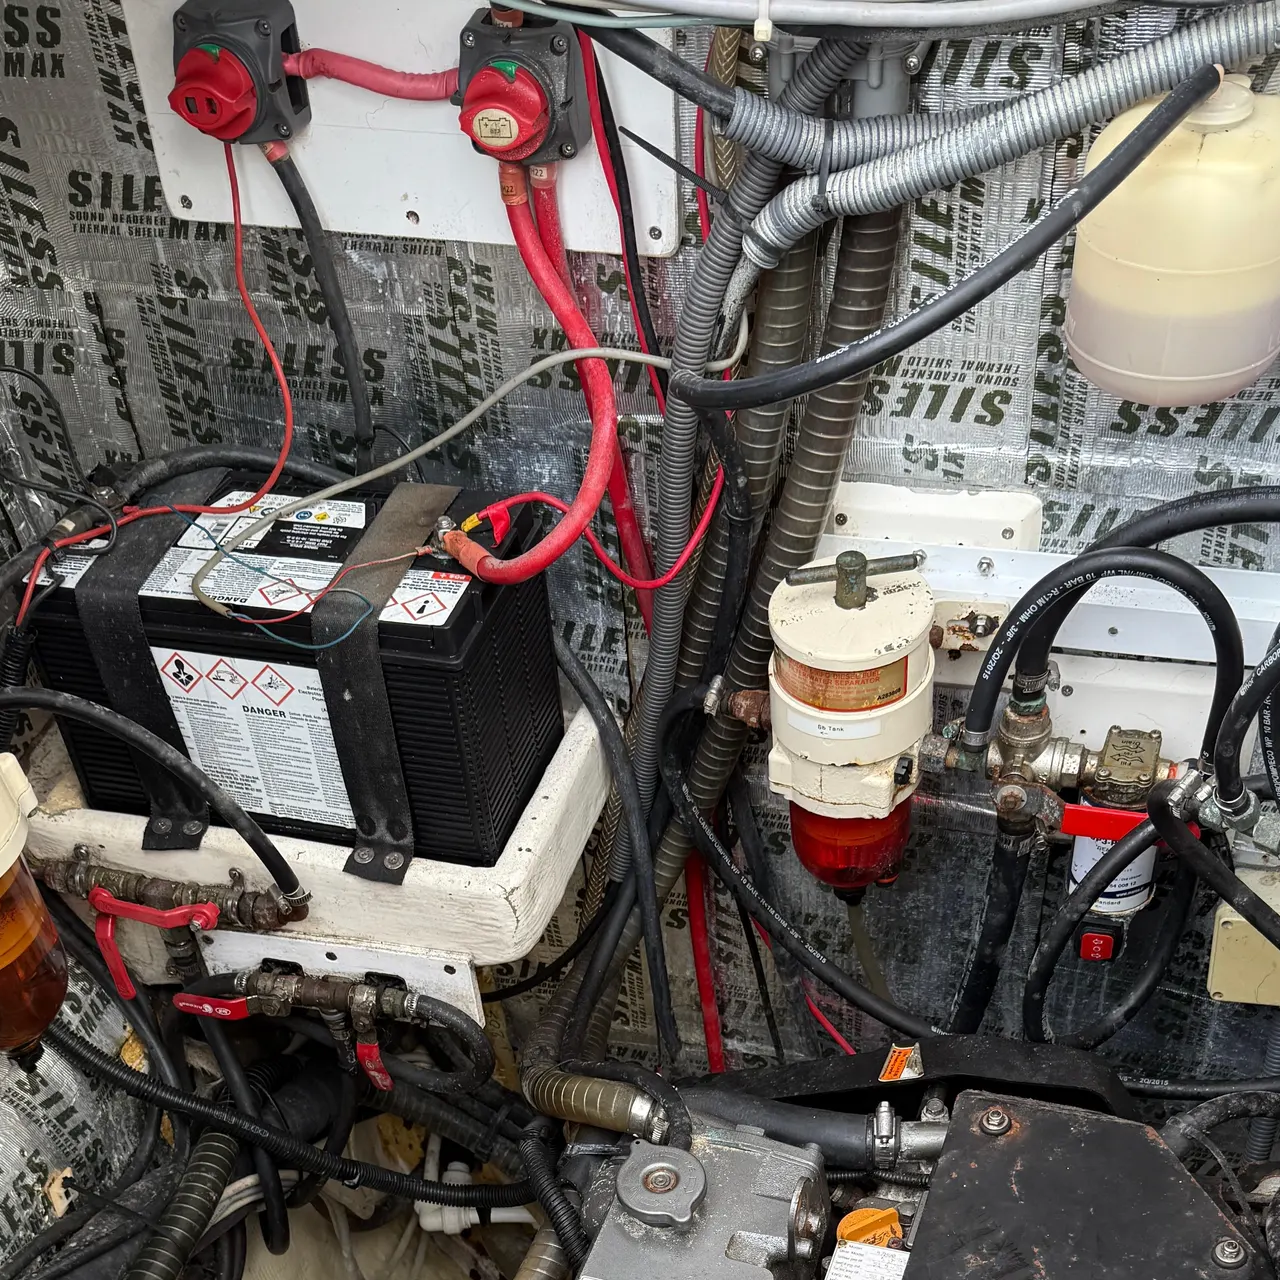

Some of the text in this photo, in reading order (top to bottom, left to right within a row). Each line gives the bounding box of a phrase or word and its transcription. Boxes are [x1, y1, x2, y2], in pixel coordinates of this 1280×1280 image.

[84, 12, 104, 69] SHIELD
[4, 52, 65, 78] MAX
[98, 67, 138, 149] MAX
[68, 169, 163, 213] SILE
[69, 210, 228, 242] SOUND DEADENER MAX
[73, 223, 165, 238] THERMAL SHIELD
[402, 243, 444, 257] SHIELD
[975, 375, 1020, 387] SOUND
[861, 380, 1013, 427] SILES
[1019, 604, 1038, 623] OHM
[1065, 575, 1085, 590] BAR
[1085, 571, 1097, 581] 10
[834, 677, 881, 686] SEPARATOR
[242, 705, 287, 719] DANGER
